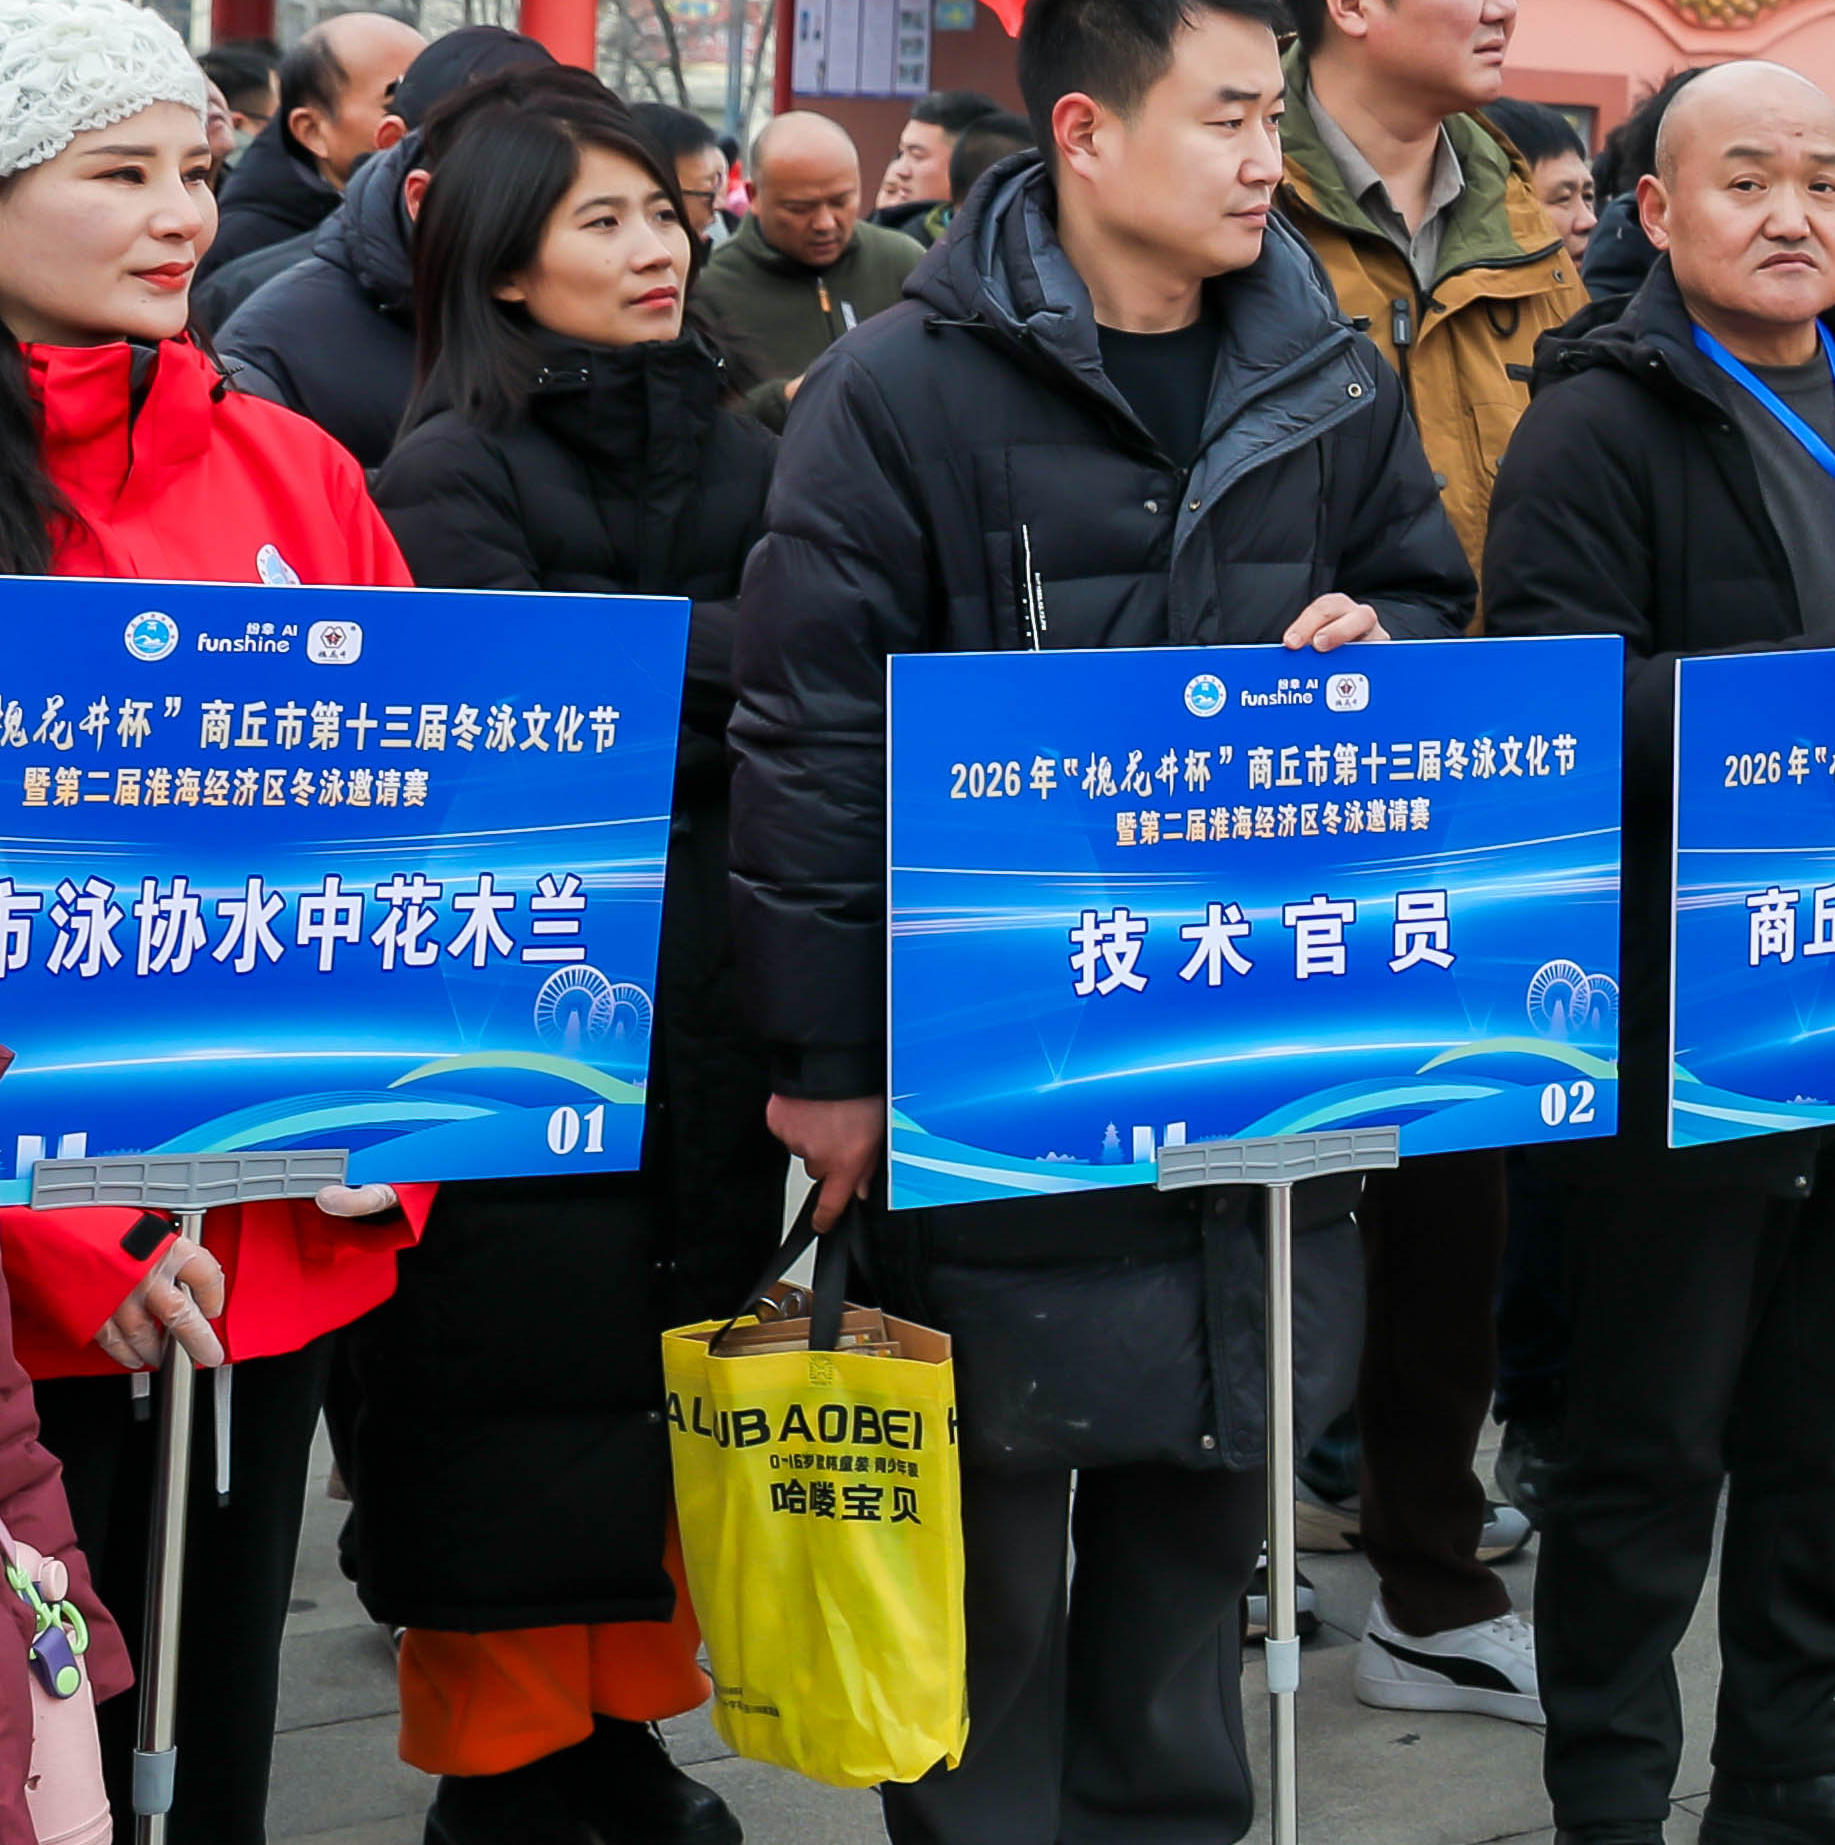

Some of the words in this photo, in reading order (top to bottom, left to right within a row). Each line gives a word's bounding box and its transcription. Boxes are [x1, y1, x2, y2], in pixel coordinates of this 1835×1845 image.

[197, 633, 290, 652] funshine
[1241, 689, 1314, 707] funshine
[200, 700, 620, 754] 商丘市第十三届冬泳文化节
[1247, 733, 1578, 790] 商丘市第十三届冬泳文化节
[22, 766, 430, 808] 暨第二届淮海经济区冬泳邀请赛
[1115, 796, 1431, 847] 暨第二届淮海经济区冬泳邀请赛
[1068, 889, 1457, 996] 技术官员
[1540, 1080, 1596, 1126] 02
[547, 1106, 604, 1155] 01
[770, 1479, 922, 1525] 哈喽宝贝
